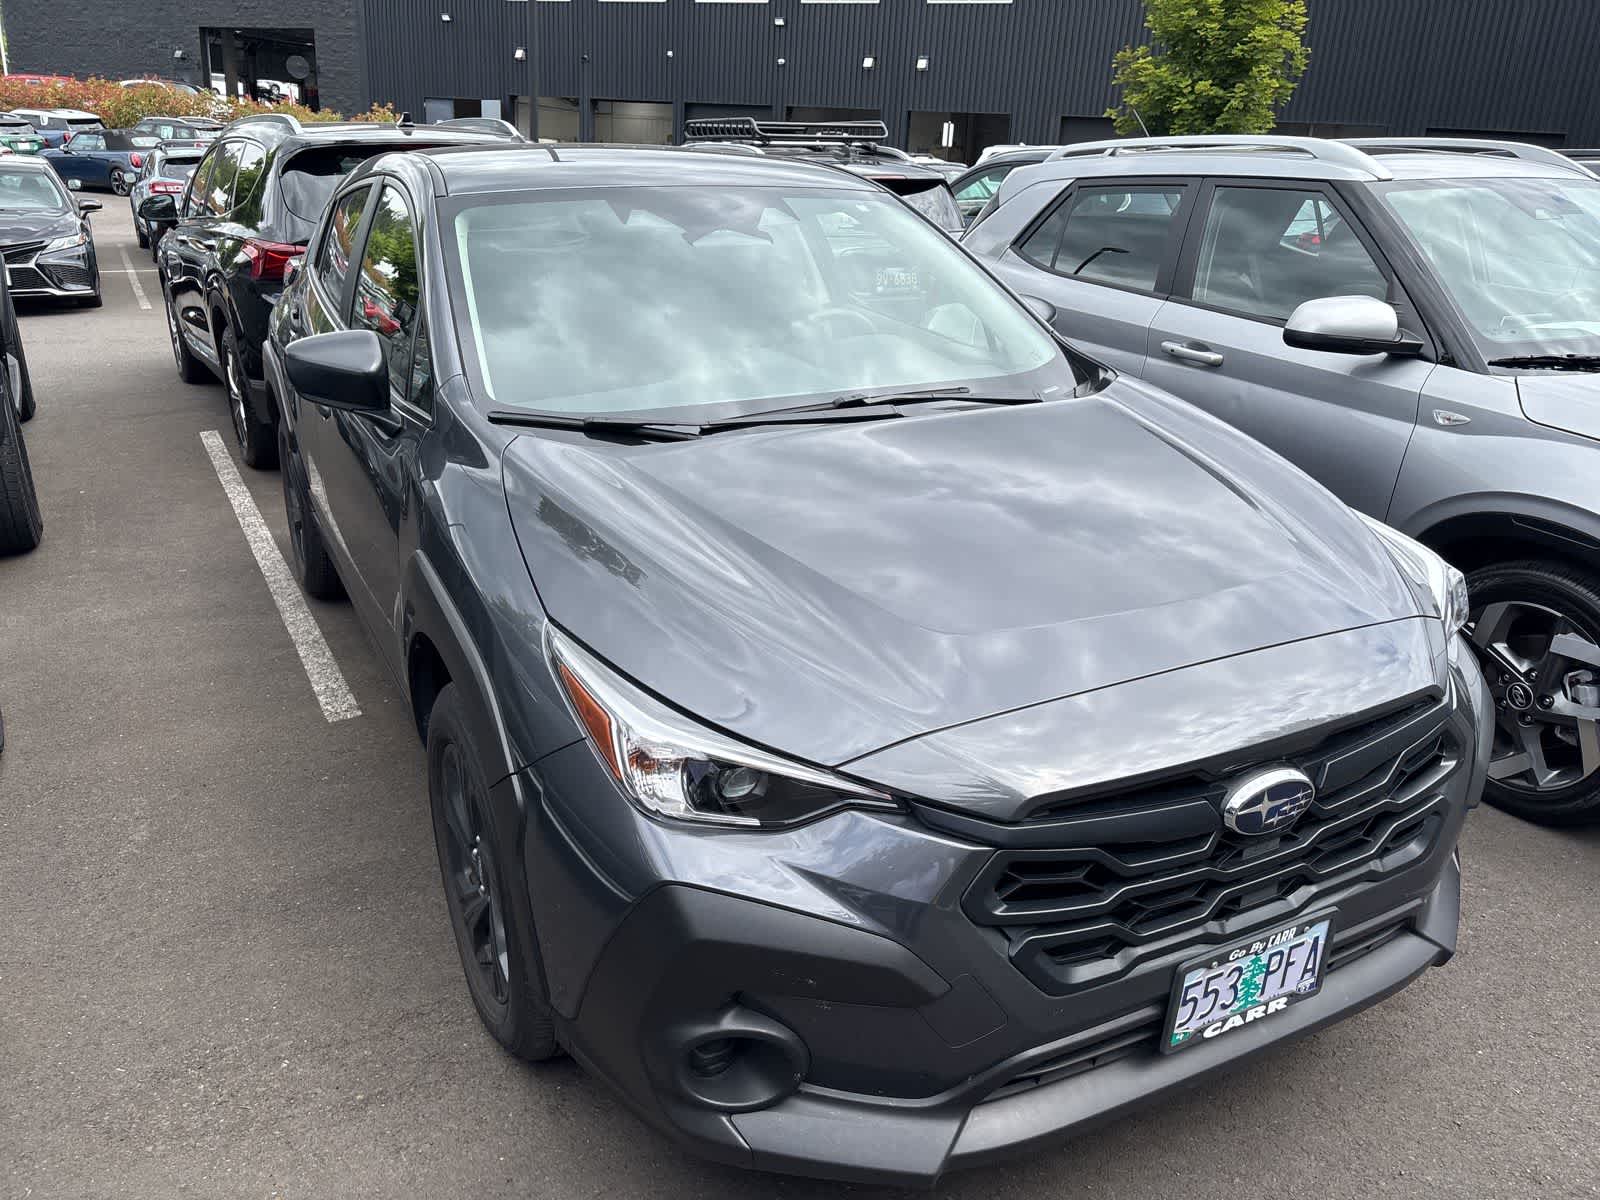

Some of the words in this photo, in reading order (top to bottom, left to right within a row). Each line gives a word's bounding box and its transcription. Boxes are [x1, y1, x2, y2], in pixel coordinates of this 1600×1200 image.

[1229, 949, 1246, 961] Go
[1250, 941, 1267, 954] By
[1267, 926, 1297, 948] CARR
[1176, 965, 1244, 1030] 553
[1259, 935, 1321, 997] PFA
[1202, 996, 1288, 1039] CARR
